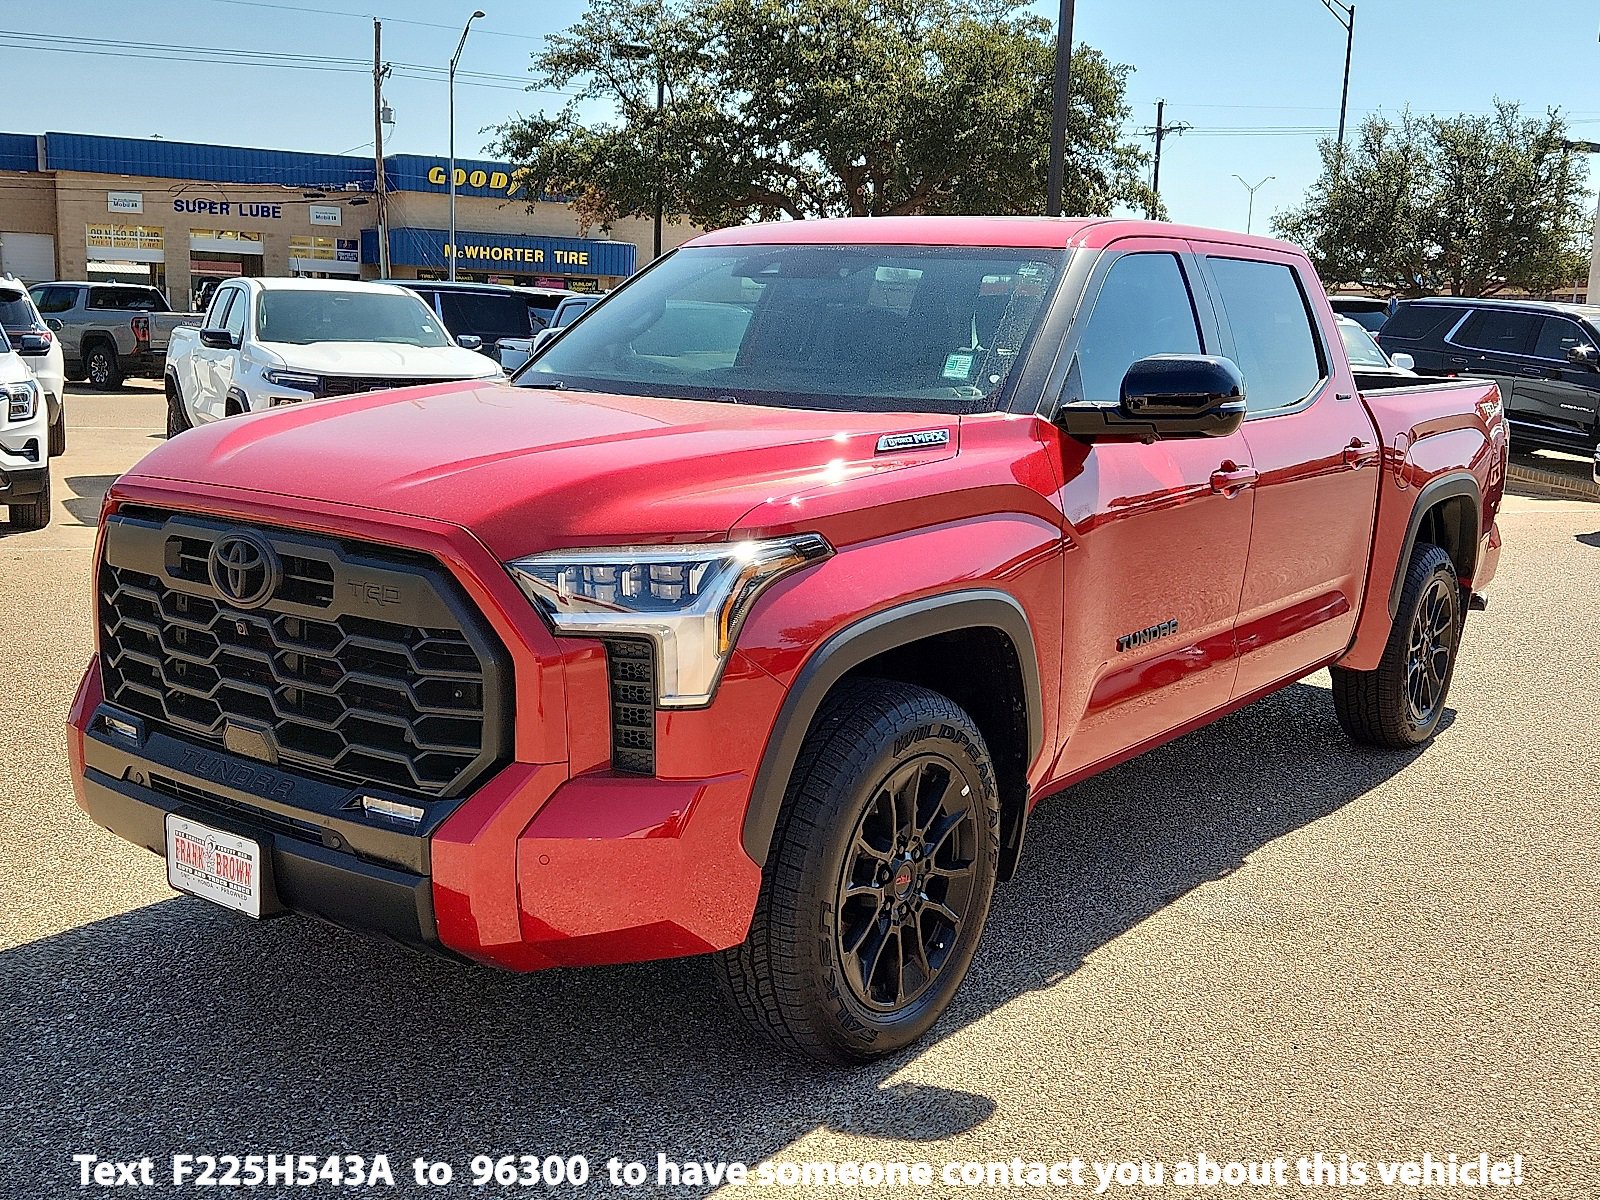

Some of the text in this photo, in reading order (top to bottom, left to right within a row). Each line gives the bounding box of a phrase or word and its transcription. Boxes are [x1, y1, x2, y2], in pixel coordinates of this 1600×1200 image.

[173, 199, 282, 219] SUPER LUBE
[129, 230, 160, 243] REPAIR
[444, 244, 589, 266] McWHORTER TIRE
[1115, 618, 1179, 652] TUNDRA
[180, 748, 296, 799] TUNDRA
[893, 724, 995, 799] WILDPEAK
[175, 837, 252, 888] FRANK BROWN
[819, 901, 879, 1044] FALKEN
